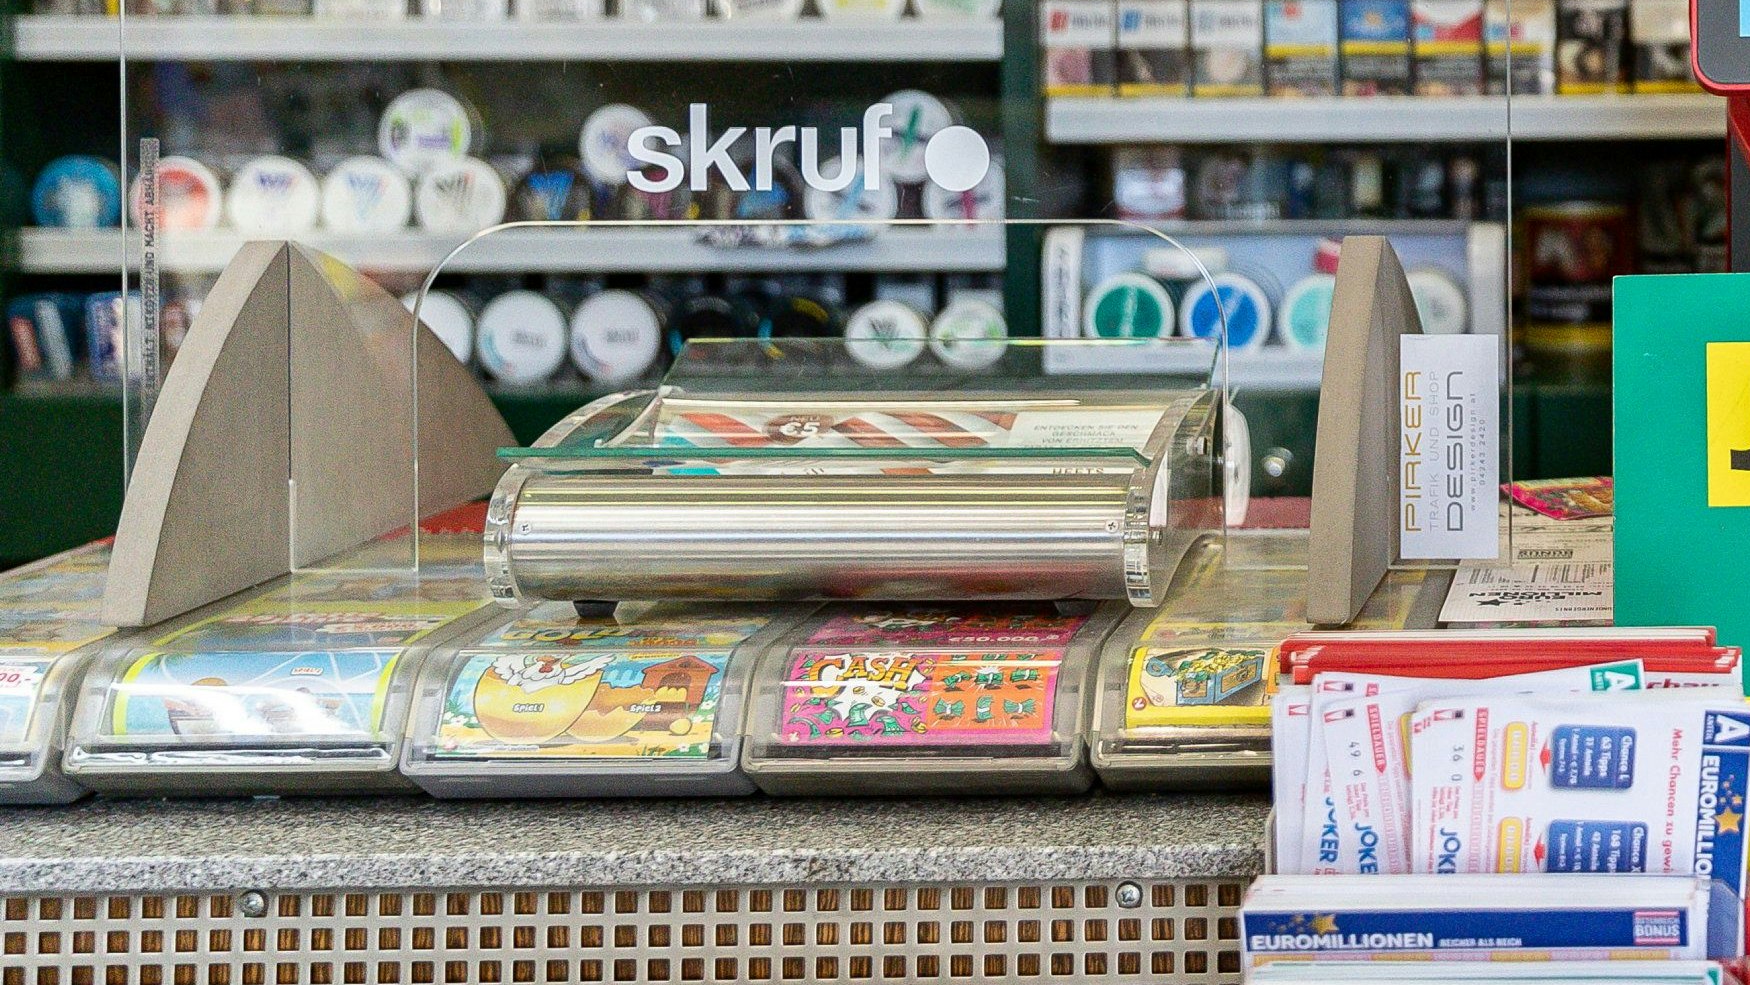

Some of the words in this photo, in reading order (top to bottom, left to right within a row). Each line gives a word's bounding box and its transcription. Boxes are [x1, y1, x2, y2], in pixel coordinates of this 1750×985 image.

[626, 103, 893, 193] skruf
[1428, 370, 1440, 416] SHOP
[1404, 370, 1422, 532] PIRKER
[1428, 426, 1440, 462] UND
[1446, 371, 1464, 532] DESIGN
[1428, 472, 1440, 533] TRAFIK
[809, 656, 923, 698] CASH
[1368, 707, 1386, 767] SPIELDAUER
[1474, 710, 1488, 775] SPIELDAUER
[1670, 728, 1683, 760] Mehr
[1714, 714, 1750, 744] A
[1597, 751, 1612, 777] Tipps
[1620, 735, 1633, 772] Chance
[1667, 762, 1681, 817] Chancen
[1664, 819, 1673, 835] zu
[1250, 932, 1435, 951] EUROMILLIONEN
[1635, 925, 1680, 938] BONUS
